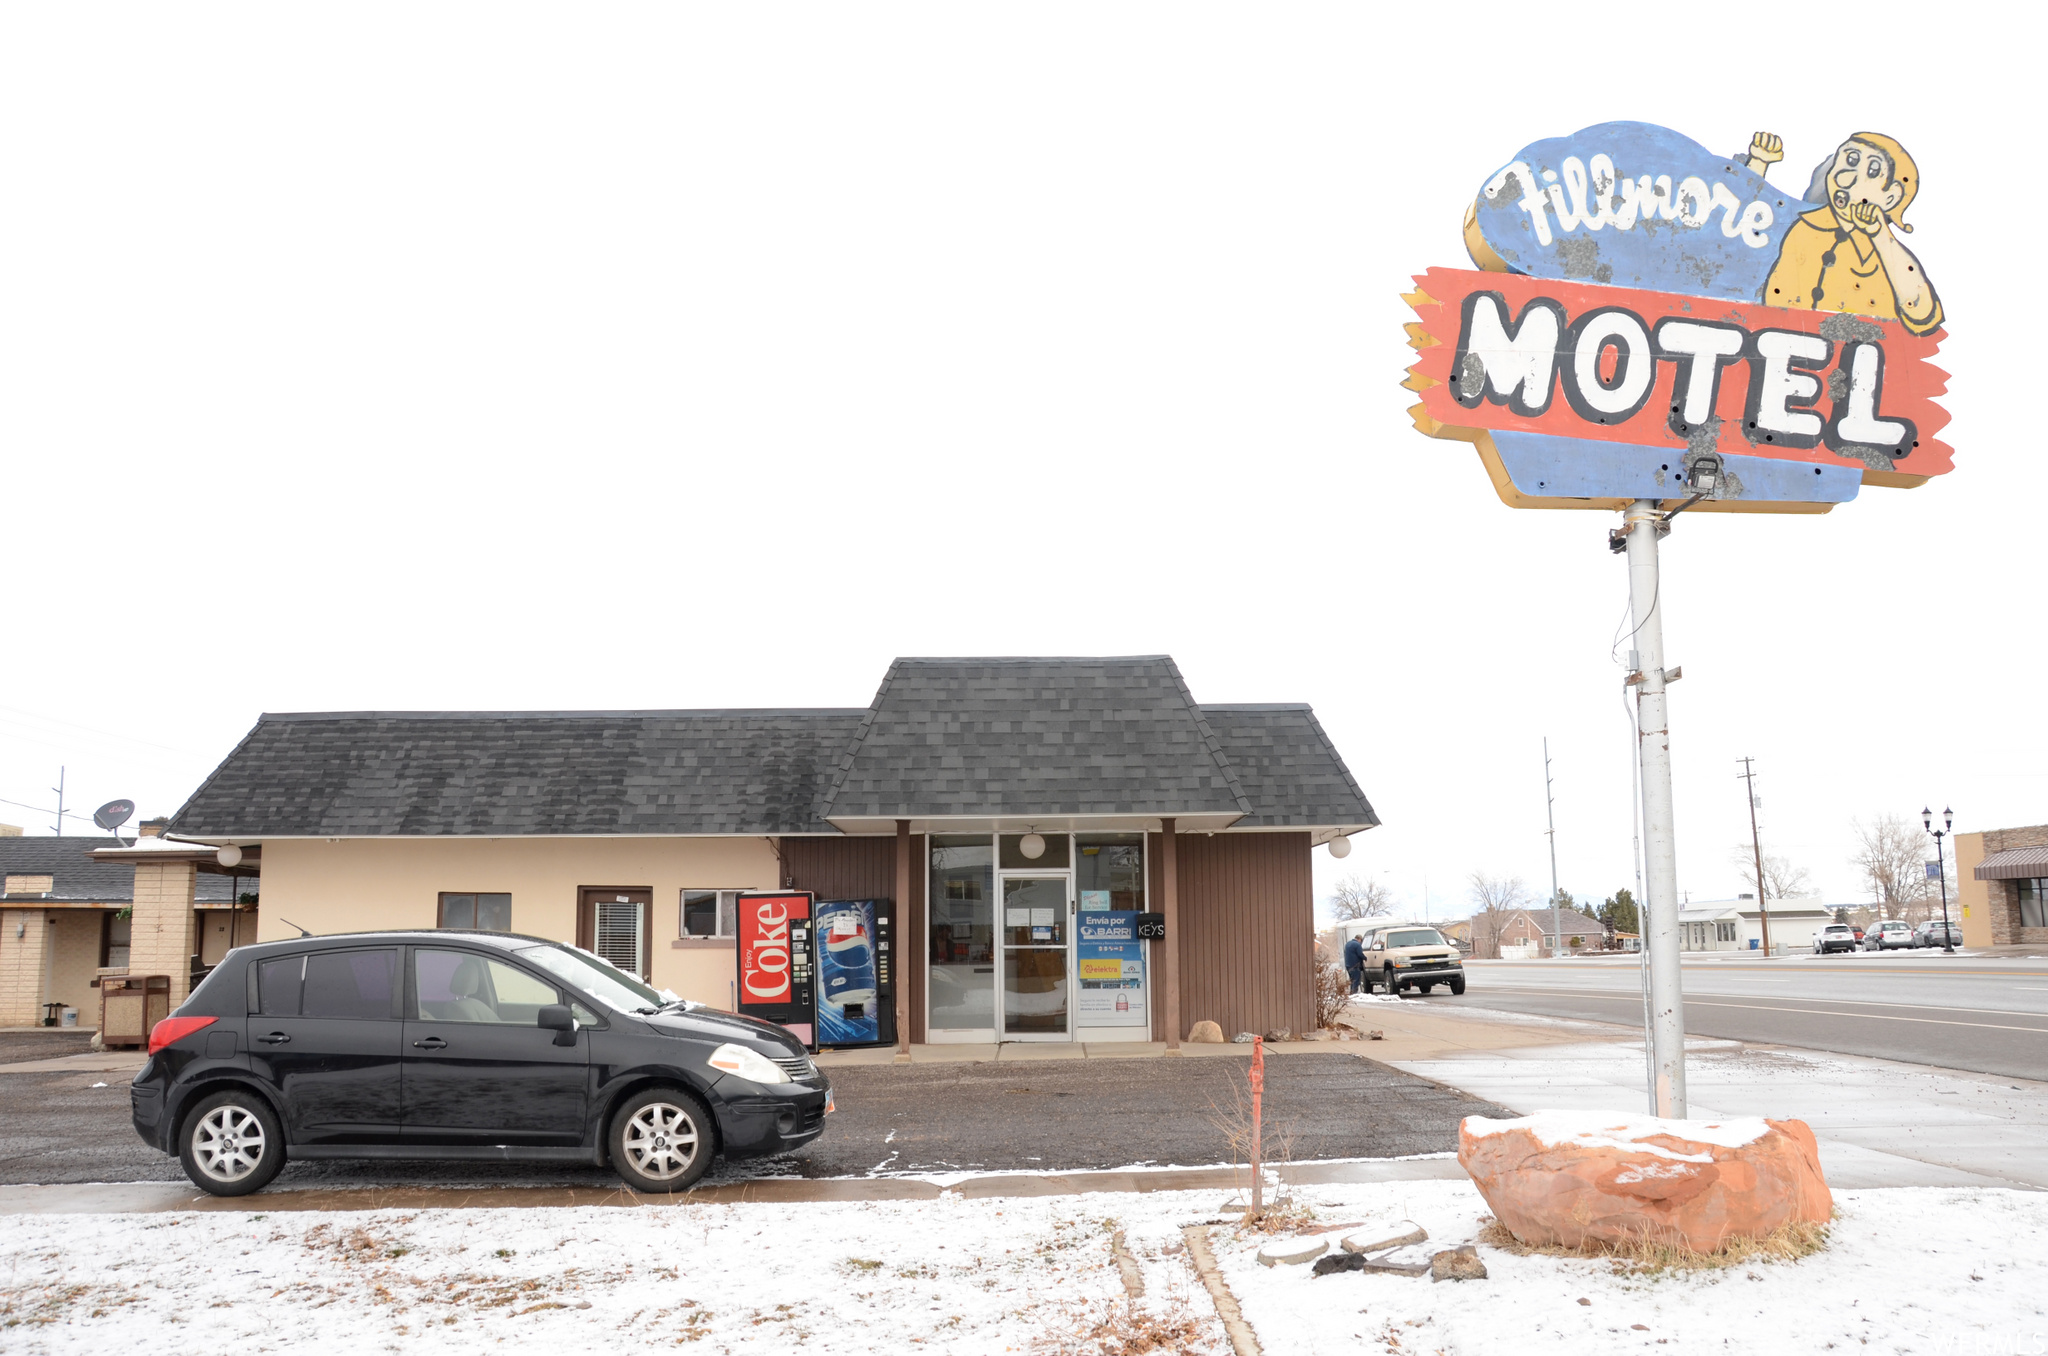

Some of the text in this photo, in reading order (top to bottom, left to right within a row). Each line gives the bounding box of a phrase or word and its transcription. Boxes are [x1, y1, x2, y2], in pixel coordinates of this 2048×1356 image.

[1483, 152, 1774, 248] Fillmore
[1452, 291, 1915, 456] MOTEL
[1086, 916, 1126, 927] Envía por
[1097, 927, 1132, 935] BARRI
[1138, 924, 1165, 937] KEYS
[744, 903, 790, 998] Coke
[744, 949, 753, 969] Enjoy
[1094, 965, 1118, 973] elektra
